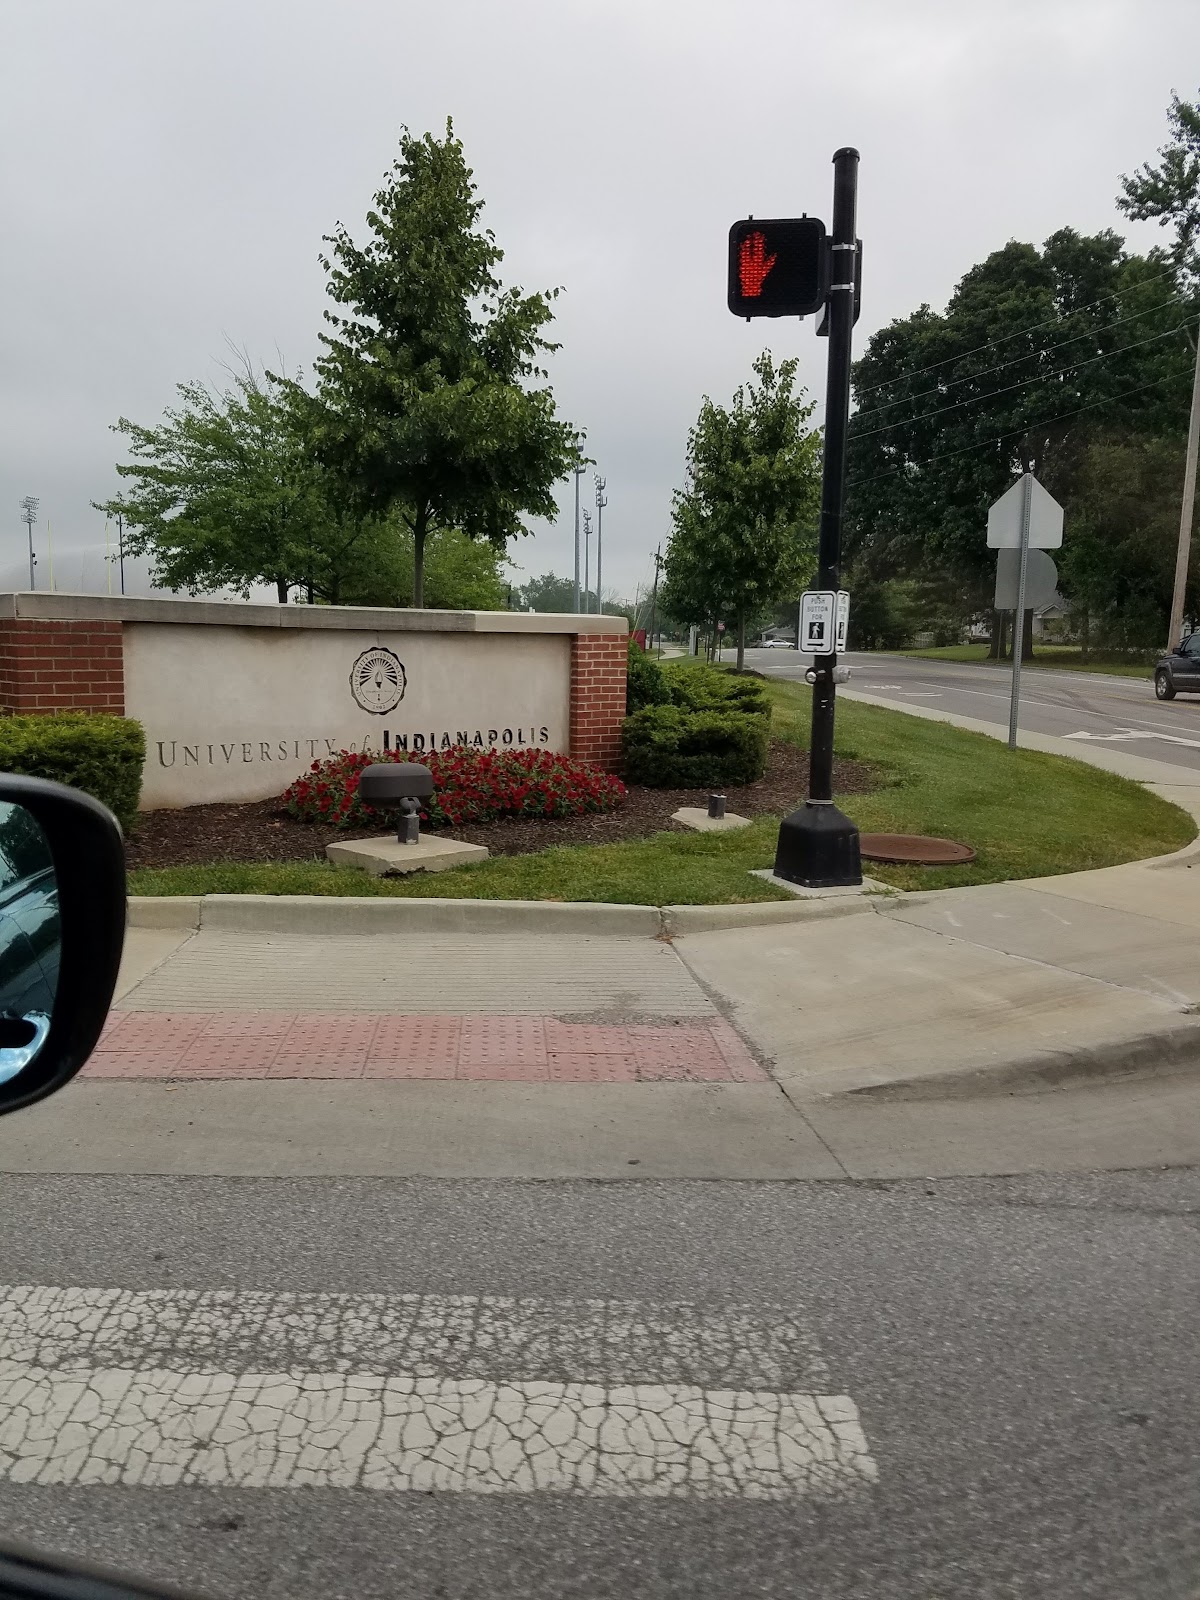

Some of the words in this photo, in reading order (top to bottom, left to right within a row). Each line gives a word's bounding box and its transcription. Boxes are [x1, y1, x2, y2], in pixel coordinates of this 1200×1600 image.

[155, 739, 336, 768] UNIVERSITY
[349, 734, 371, 753] of
[383, 727, 549, 752] INDIANAPOLIS
